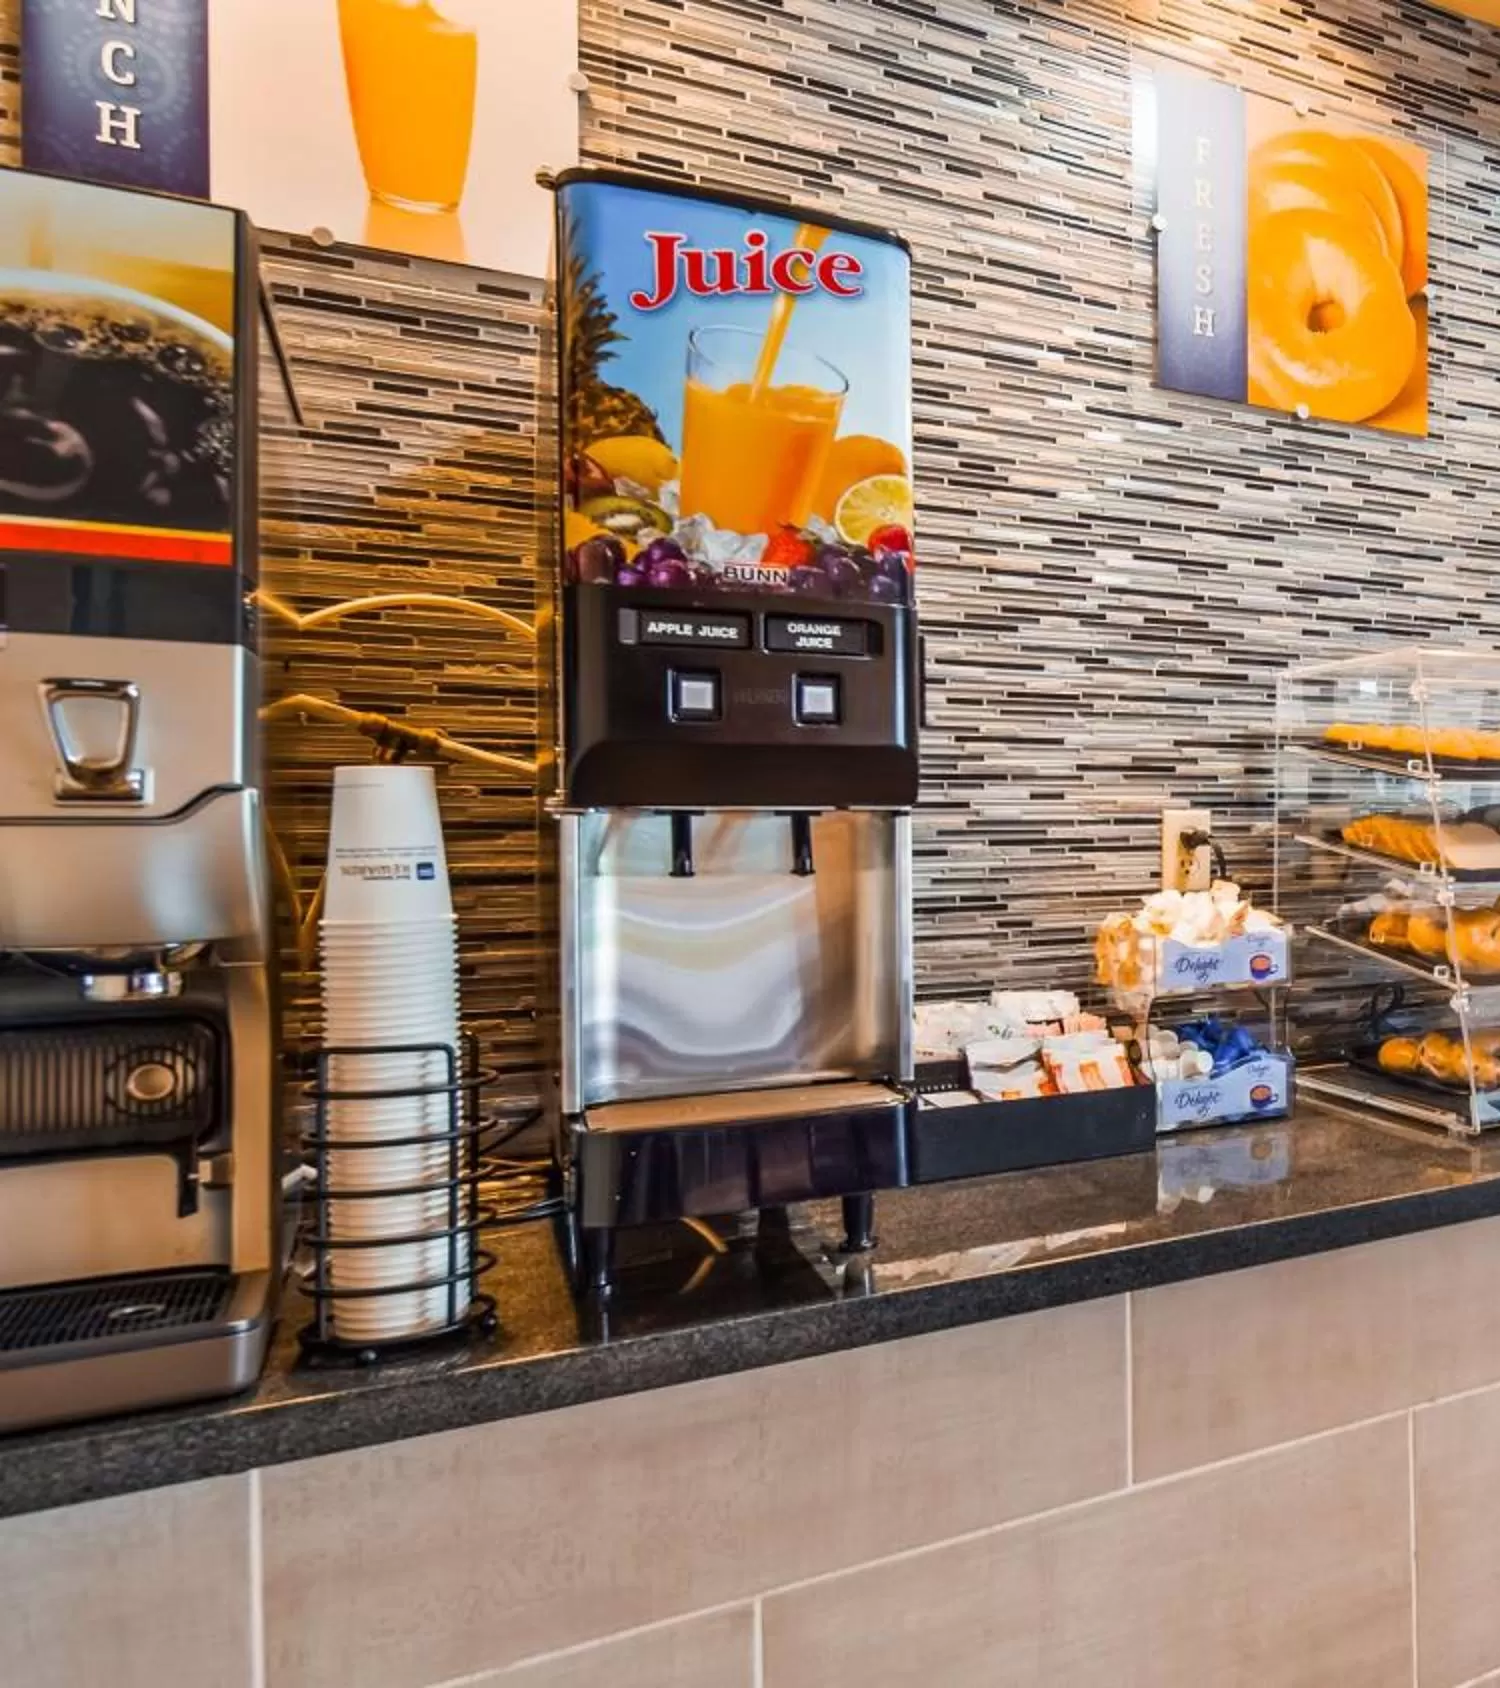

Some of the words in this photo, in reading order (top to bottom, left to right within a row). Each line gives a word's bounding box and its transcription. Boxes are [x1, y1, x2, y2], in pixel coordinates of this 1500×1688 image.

[1193, 136, 1216, 337] FRESH
[630, 230, 863, 311] Juice
[723, 566, 788, 585] BUNN
[647, 621, 693, 636] APPLE
[698, 625, 739, 639] JUICE
[787, 622, 842, 636] ORANGE
[795, 636, 833, 649] JUICE
[1174, 956, 1221, 983] Delight
[1174, 1091, 1221, 1118] Delight
